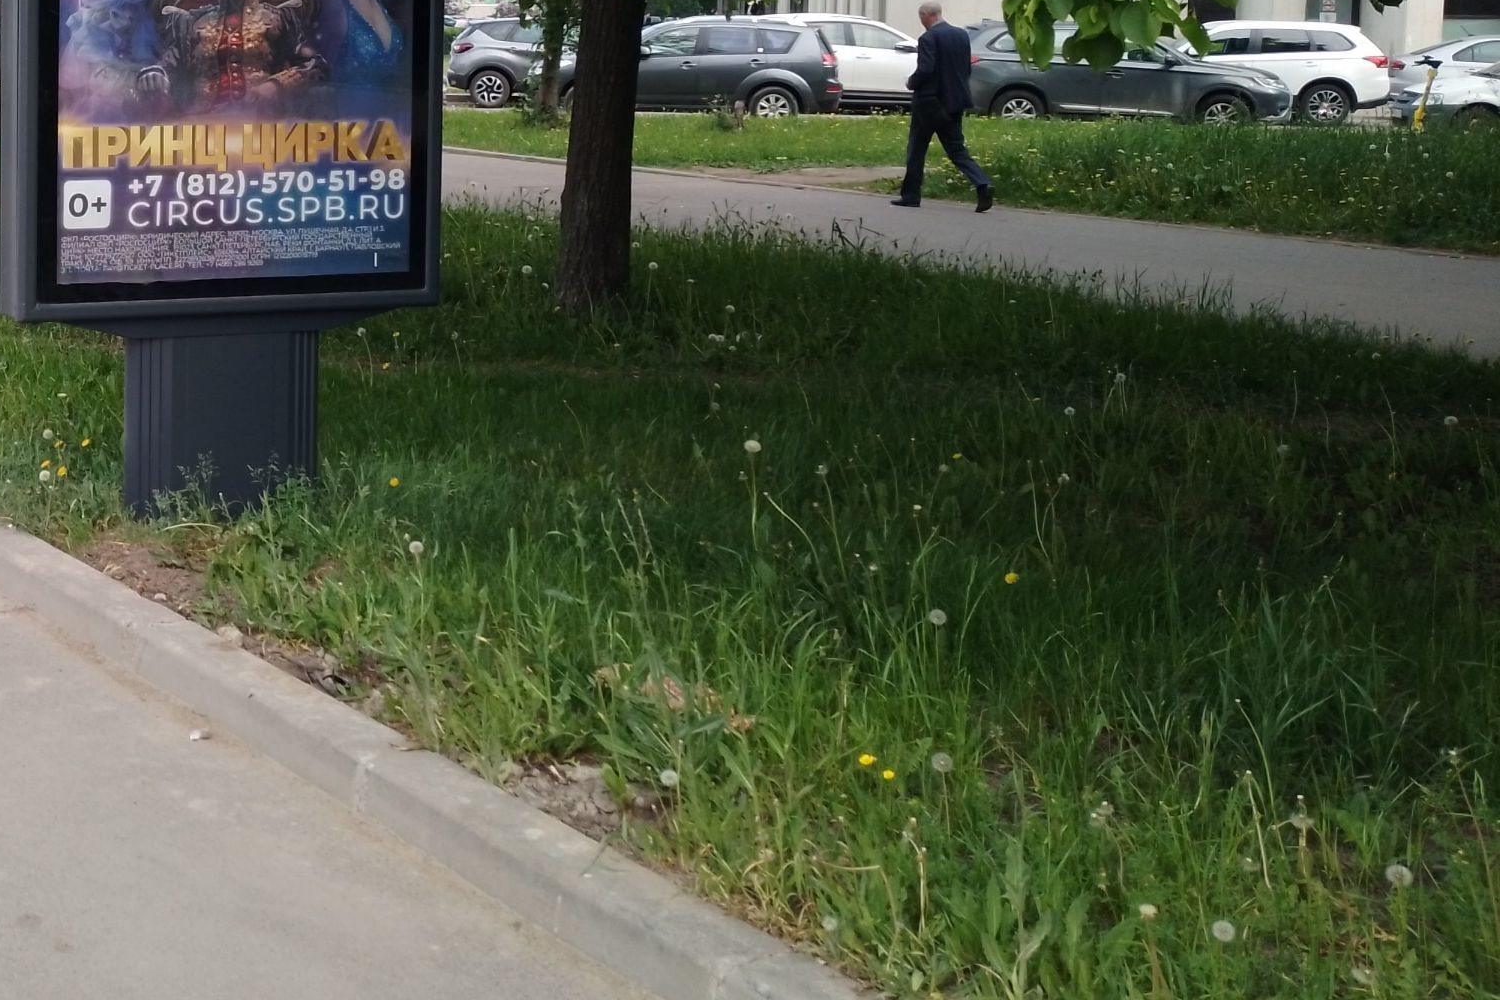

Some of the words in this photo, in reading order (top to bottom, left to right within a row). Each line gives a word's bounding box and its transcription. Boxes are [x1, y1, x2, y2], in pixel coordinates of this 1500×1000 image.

[62, 123, 228, 171] ПРИНЦ
[243, 119, 406, 169] ЦИРКА
[128, 175, 163, 197] +7
[176, 168, 406, 199] (812)-570-51-98
[68, 193, 107, 217] 0+
[128, 194, 405, 227] CIRCUS.SPB.RU
